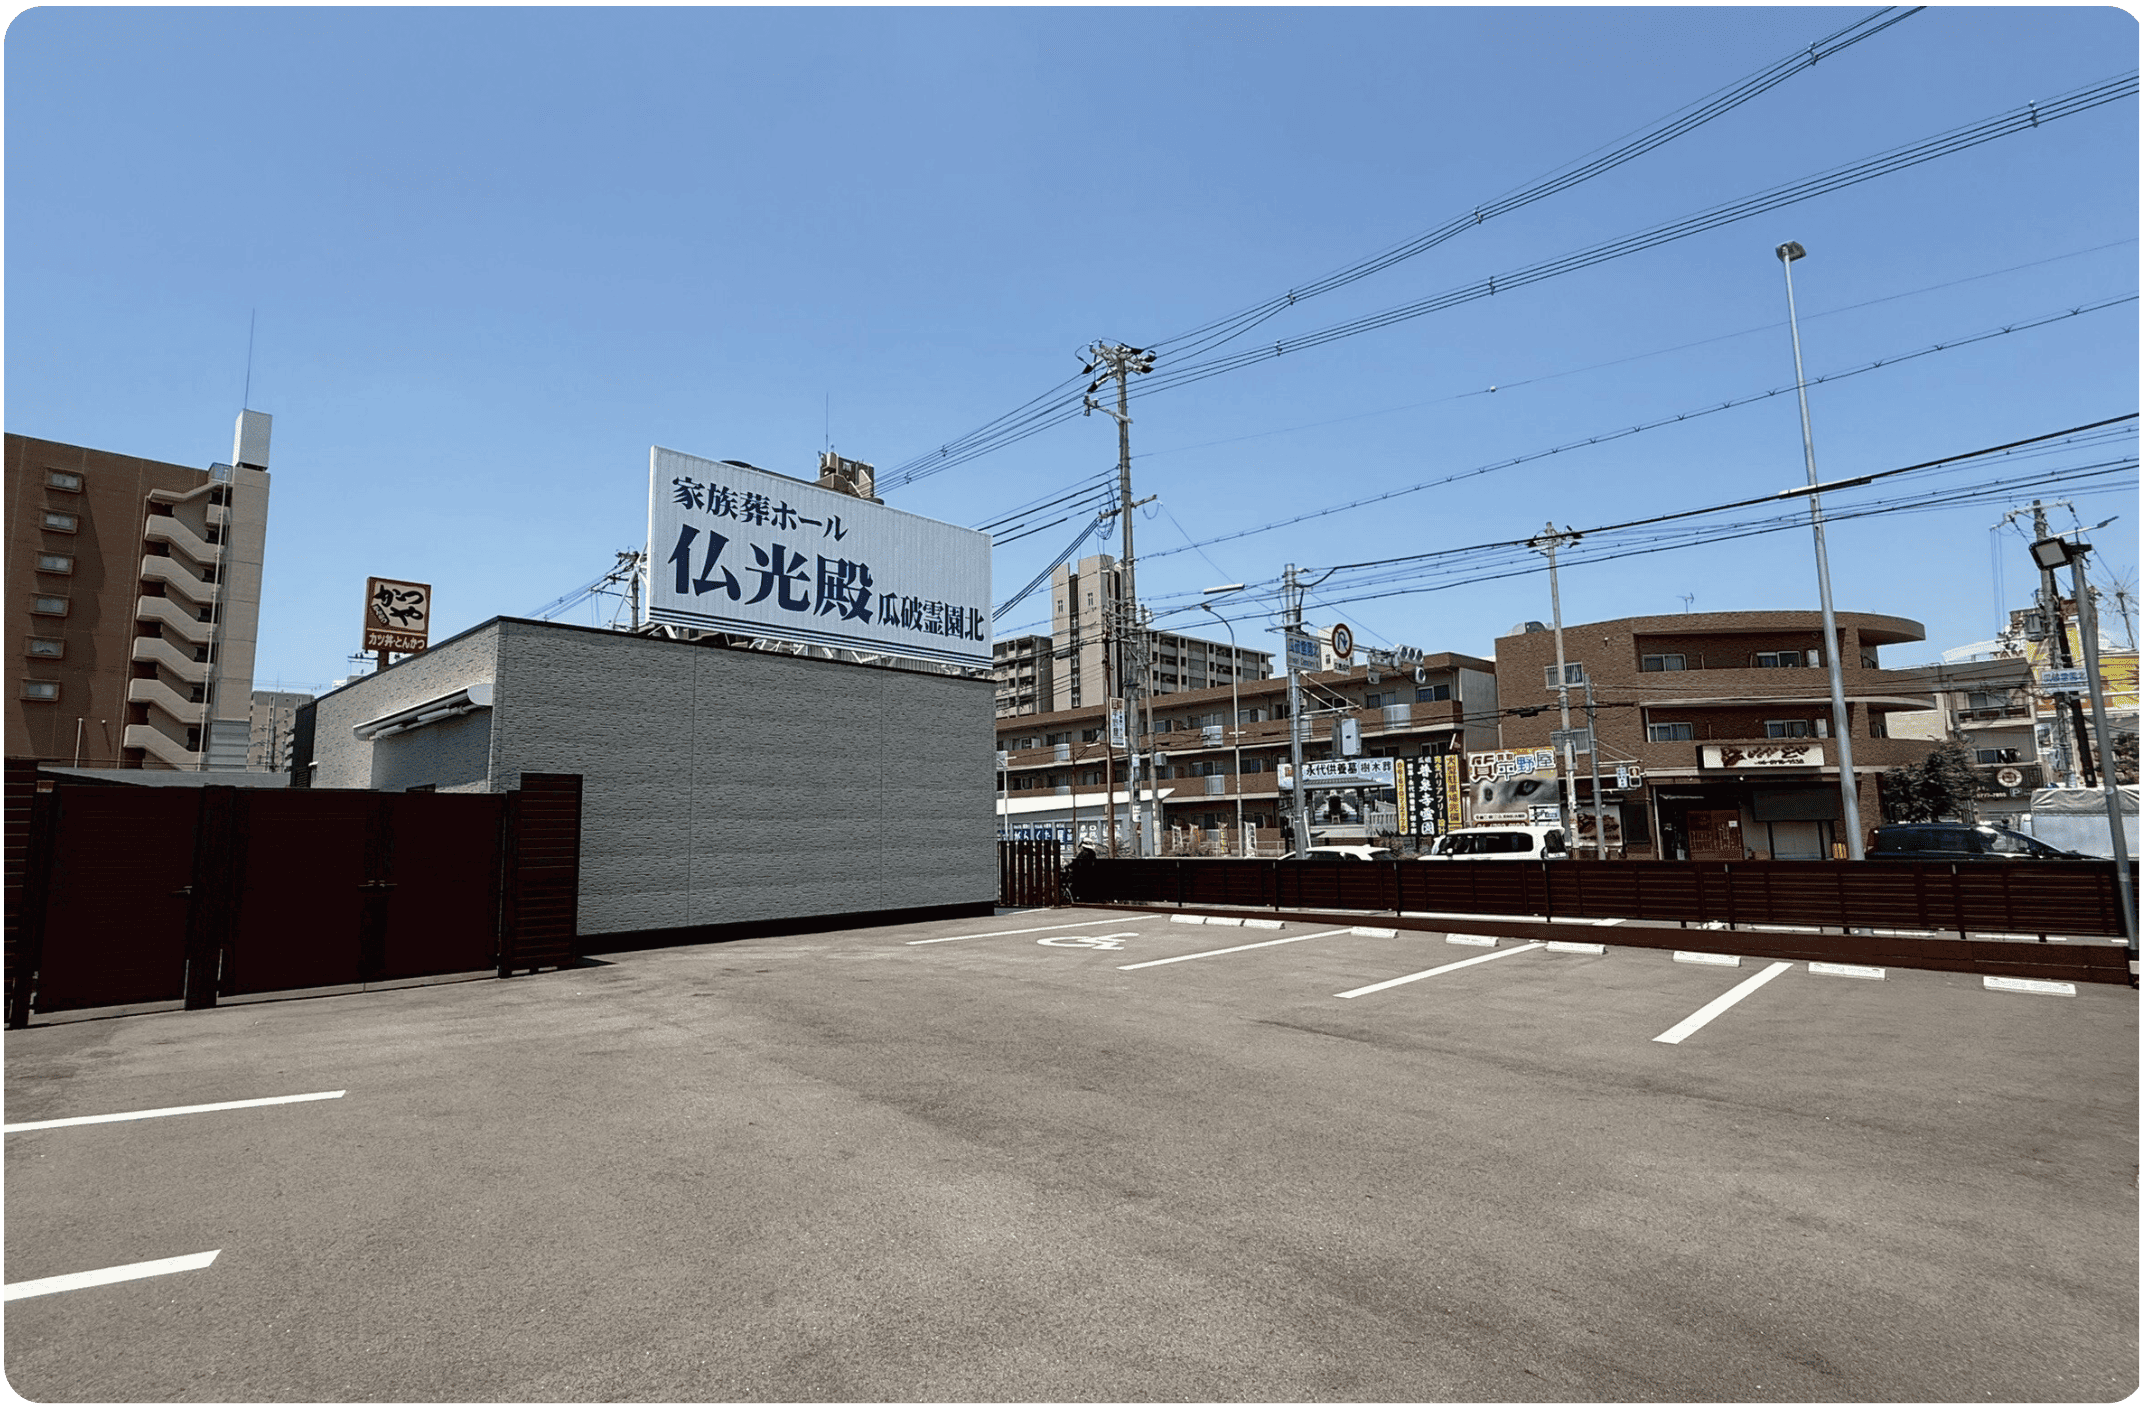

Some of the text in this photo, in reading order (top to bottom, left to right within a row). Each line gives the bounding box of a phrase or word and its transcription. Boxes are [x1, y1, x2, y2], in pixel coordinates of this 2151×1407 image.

[671, 475, 849, 543] 家族葬ホール
[667, 522, 985, 642] 仏光殿 瓜破霊園北
[1306, 762, 1357, 777] 永代供養墓
[1360, 761, 1392, 773] 樹木葬
